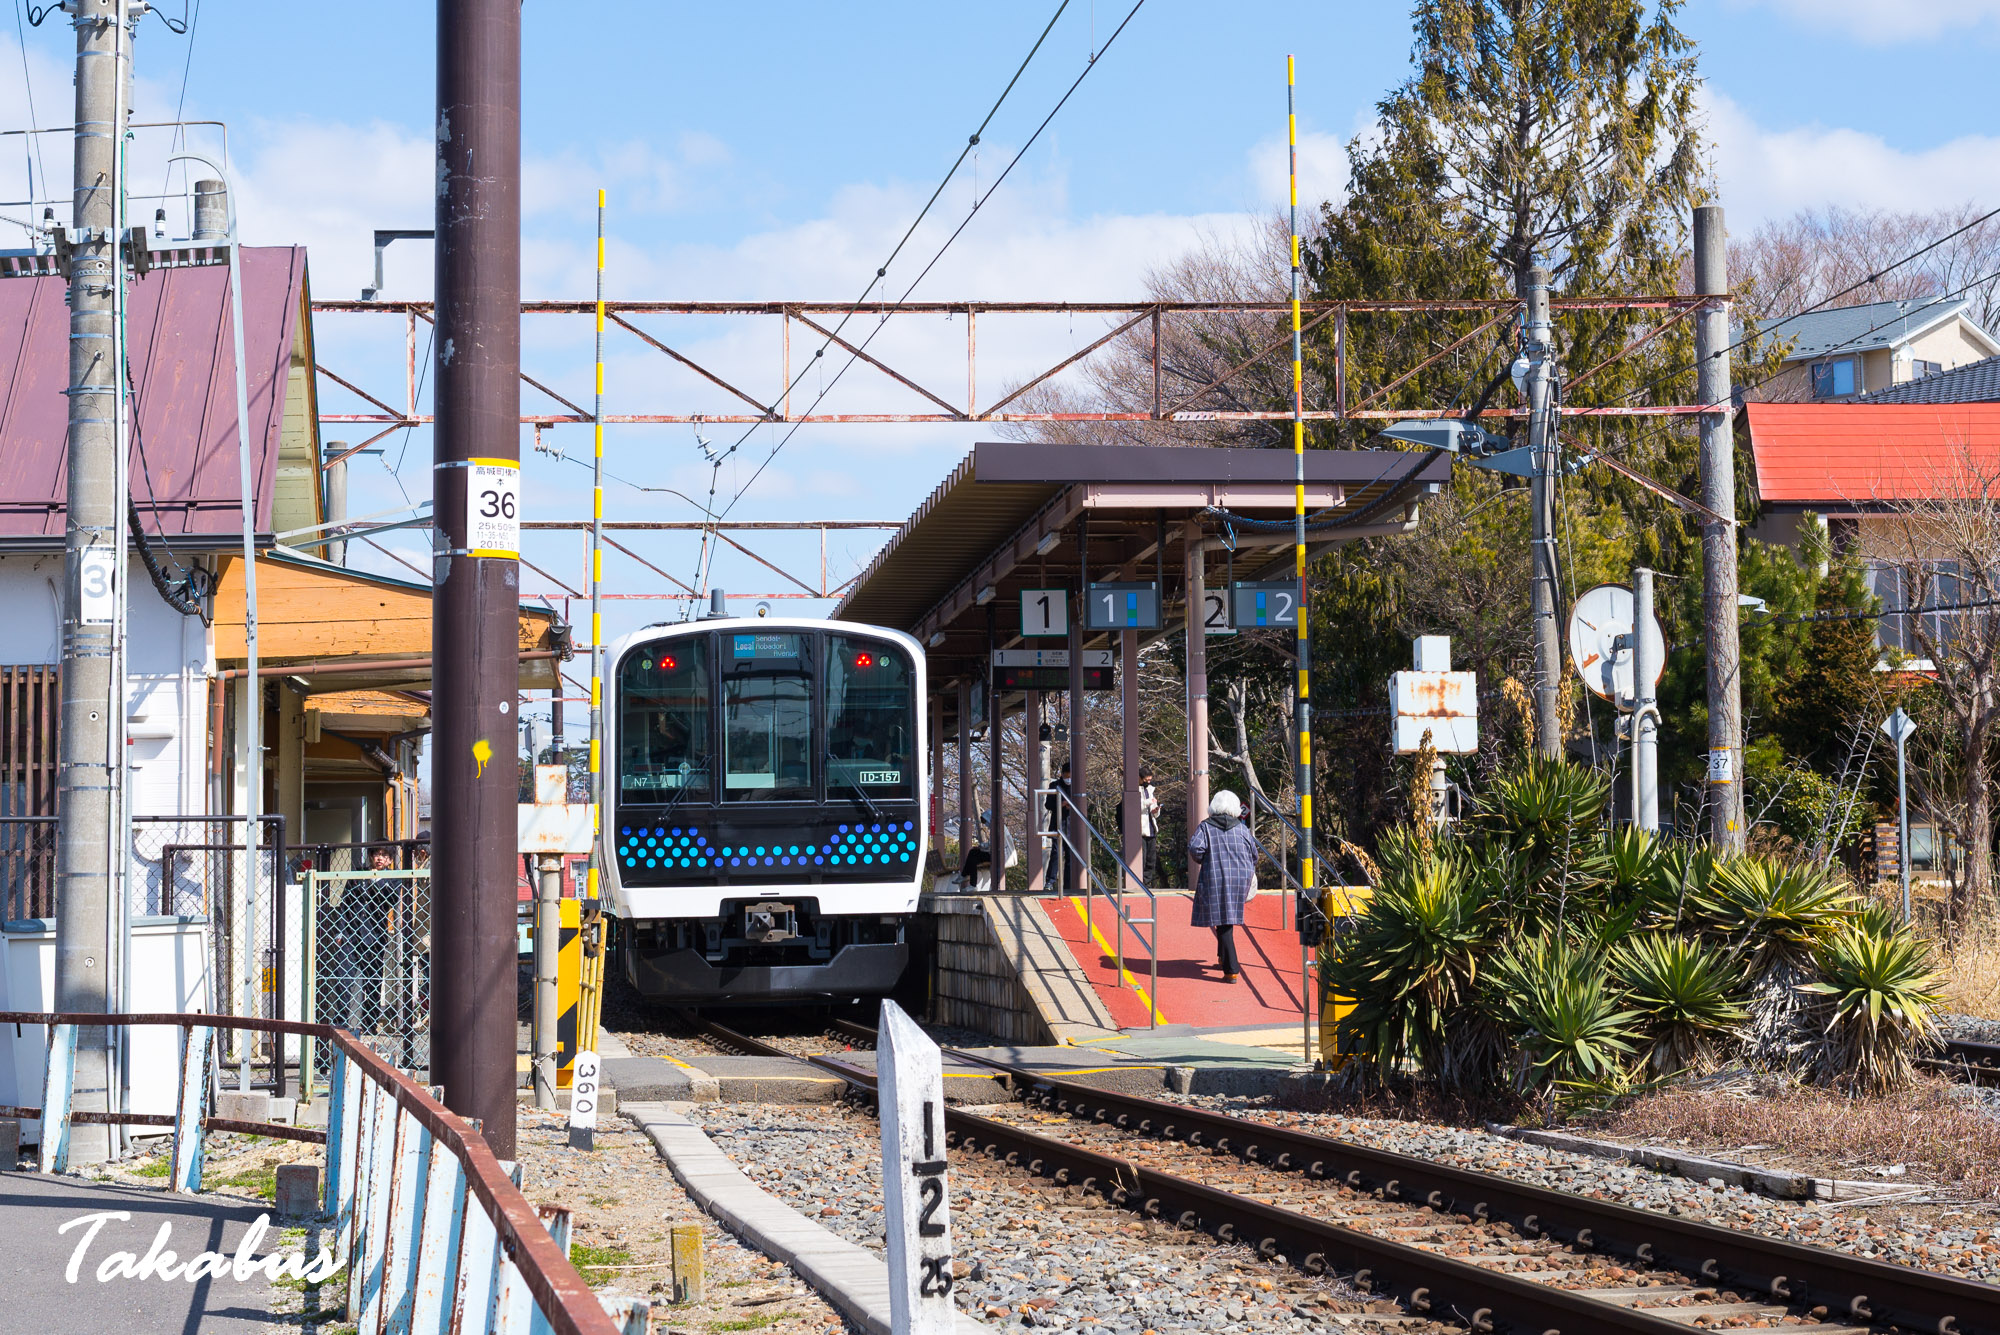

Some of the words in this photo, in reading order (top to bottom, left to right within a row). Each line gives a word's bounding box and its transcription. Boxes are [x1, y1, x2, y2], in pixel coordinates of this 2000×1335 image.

[480, 490, 515, 519] 36
[83, 564, 115, 599] 3
[1036, 595, 1050, 629] 1
[1102, 593, 1114, 623] 1
[1204, 595, 1225, 628] 2
[1274, 592, 1294, 622] 2
[735, 641, 754, 650] Local
[998, 651, 1004, 665] 1
[1101, 651, 1110, 665] 2
[863, 773, 898, 782] ID-157
[1713, 759, 1728, 769] 37
[634, 777, 648, 787] N7
[1240, 806, 1247, 815] 2
[576, 1064, 596, 1113] 360
[919, 1177, 946, 1237] 2
[920, 1254, 953, 1298] 25
